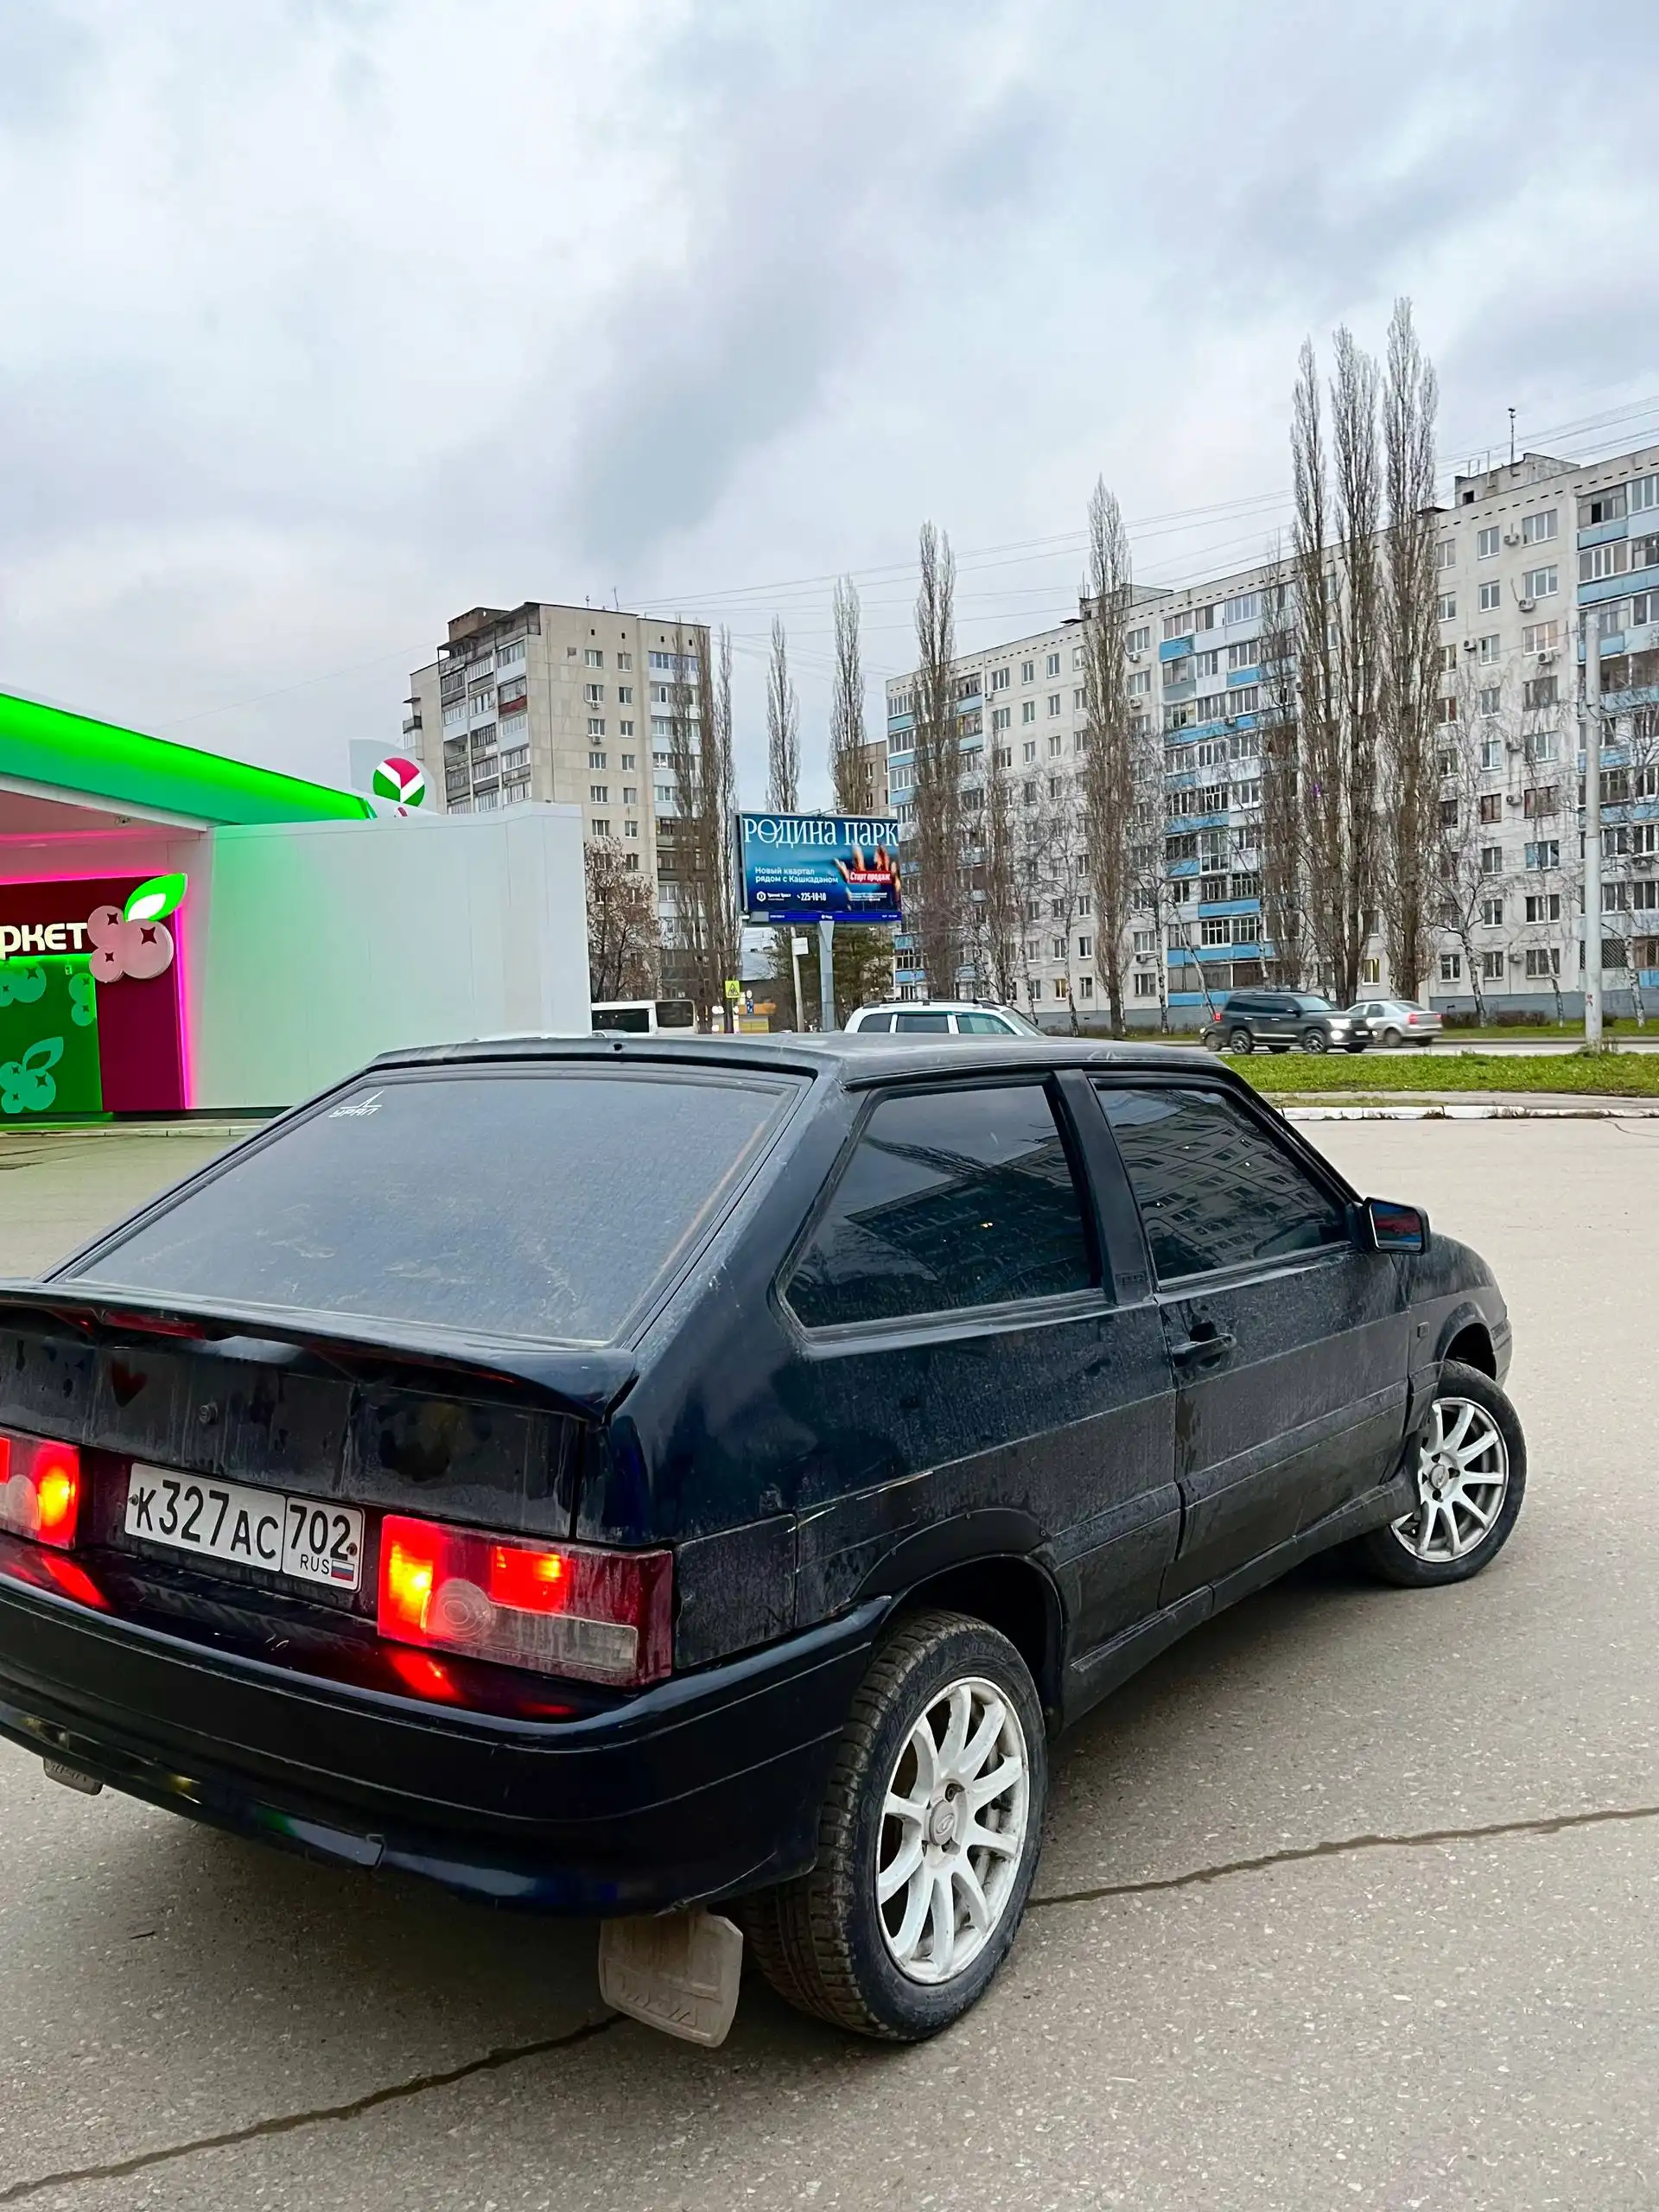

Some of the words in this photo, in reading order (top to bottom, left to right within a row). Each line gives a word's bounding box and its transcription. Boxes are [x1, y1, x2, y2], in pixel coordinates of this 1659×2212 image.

[755, 867, 782, 875] Новый
[783, 868, 815, 877] квартал
[850, 871, 867, 882] Старт
[867, 873, 891, 882] продаж
[755, 875, 781, 884] рядом
[789, 875, 839, 884] Кашкаданом
[801, 892, 827, 901] 225-10-10
[137, 1479, 278, 1560] К327АС
[289, 1504, 352, 1561] 702
[300, 1554, 331, 1575] RUS
